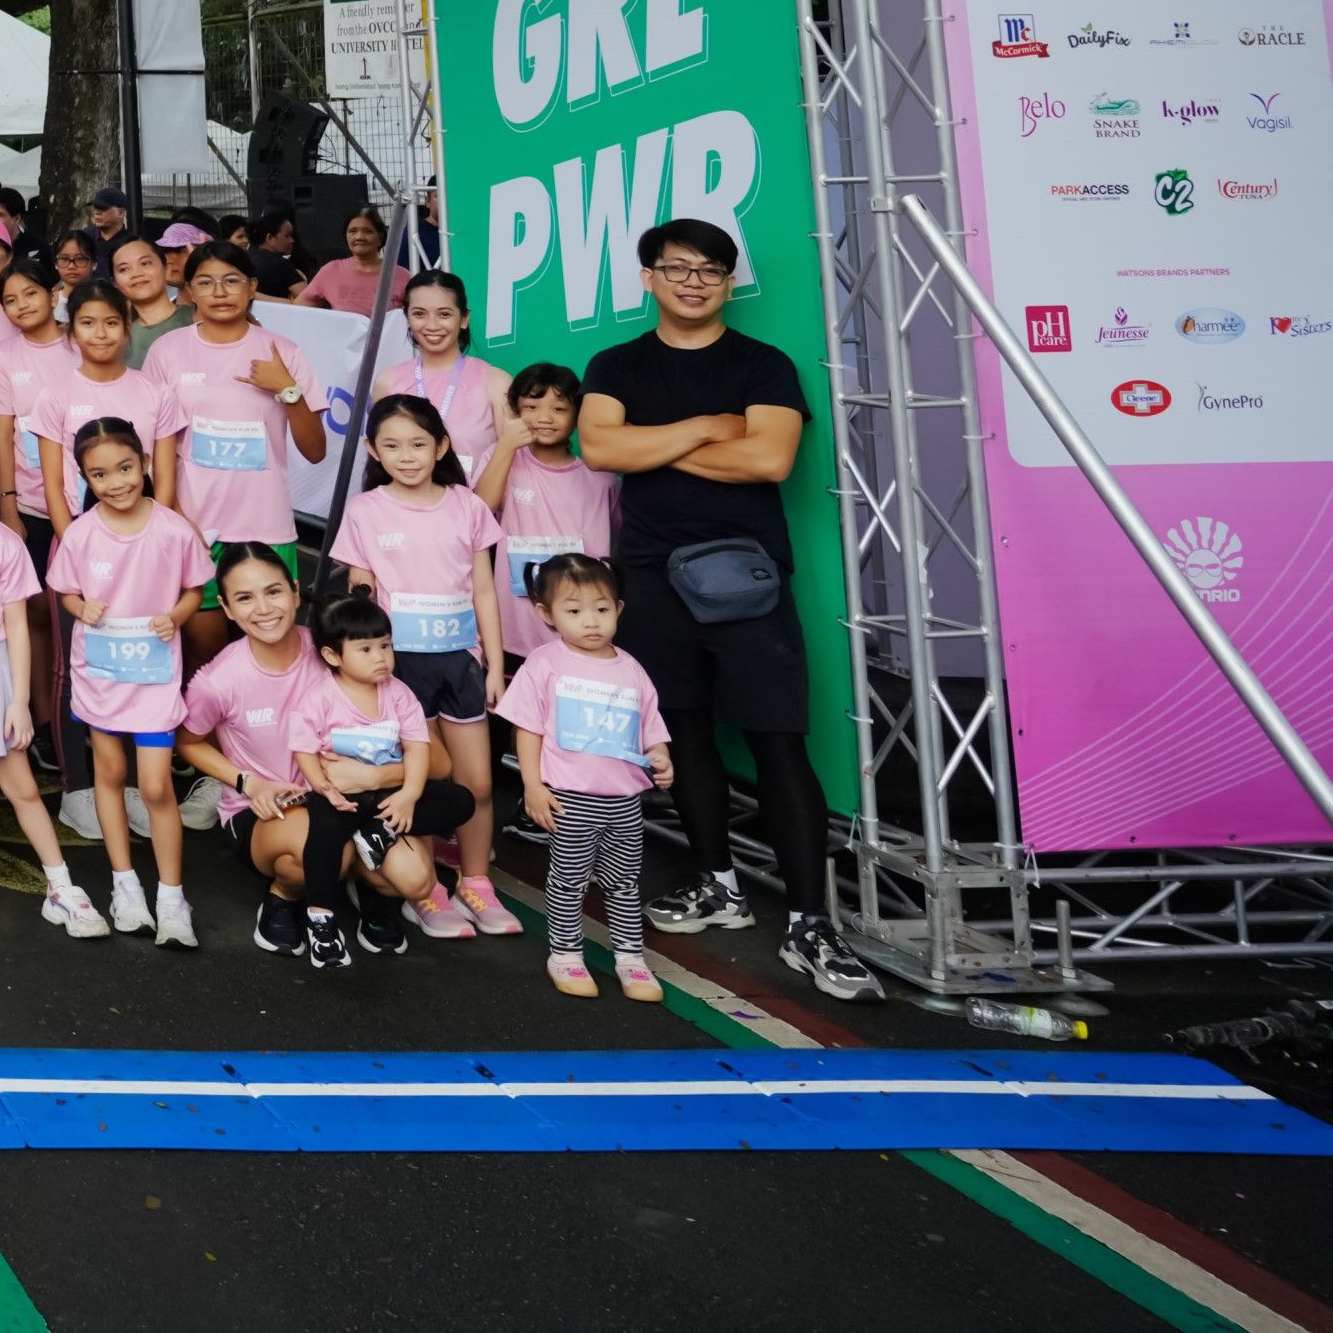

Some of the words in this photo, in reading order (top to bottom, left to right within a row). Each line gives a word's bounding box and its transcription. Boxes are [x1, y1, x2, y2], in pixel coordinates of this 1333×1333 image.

[331, 39, 389, 54] UNIVERSITY
[1067, 31, 1131, 48] DailyFix
[995, 44, 1043, 57] McCormick
[1018, 92, 1066, 137] Belo
[1093, 119, 1139, 129] SNAKE
[1096, 129, 1141, 138] BRAND
[1051, 184, 1130, 196] PARKACCESS
[1154, 174, 1194, 213] C2
[1222, 181, 1273, 199] Century
[485, 110, 762, 348] PWR
[1031, 312, 1066, 346] pH
[1095, 326, 1150, 344] Jeunesse
[1203, 395, 1264, 412] GynePro
[209, 440, 247, 458] 177
[419, 618, 460, 638] 182
[108, 641, 150, 660] 199
[584, 707, 632, 733] 147
